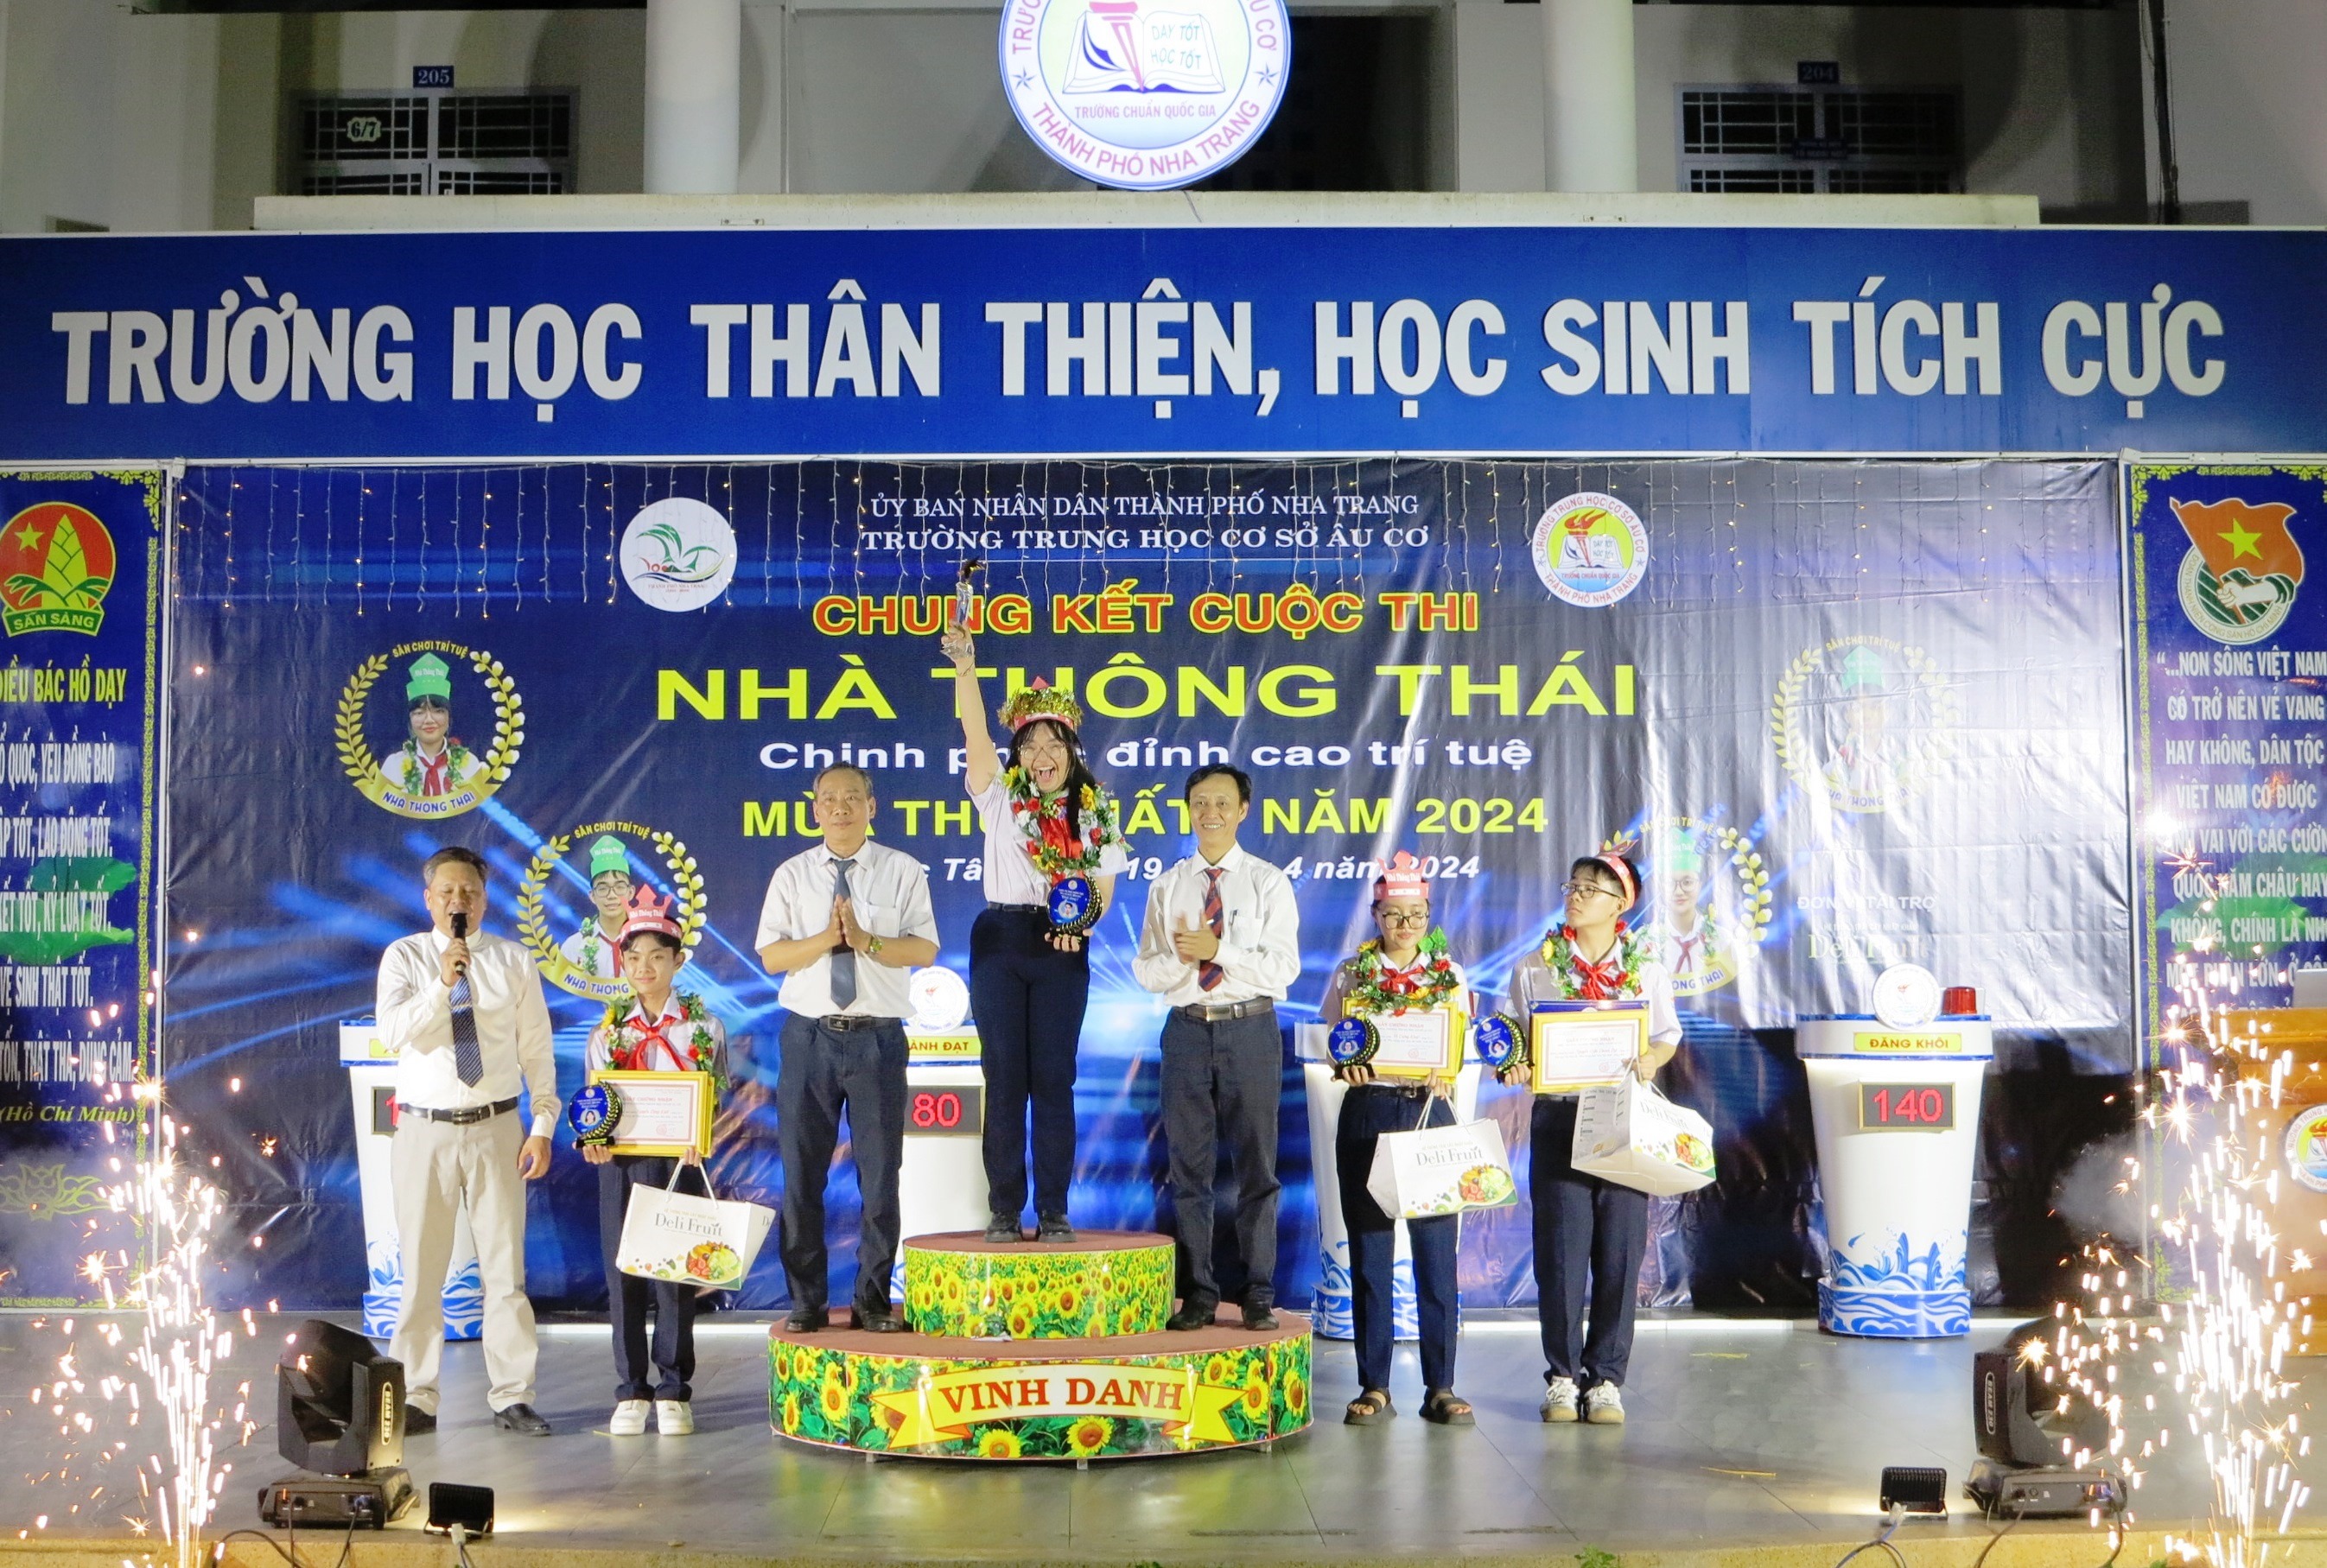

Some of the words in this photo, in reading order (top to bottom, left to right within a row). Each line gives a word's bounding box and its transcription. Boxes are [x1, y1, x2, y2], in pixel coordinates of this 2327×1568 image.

[1255, 20, 1278, 52] CƠ
[417, 69, 450, 84] 205
[1802, 65, 1834, 80] 204
[1075, 102, 1120, 119] TRƯỜNG
[1123, 99, 1161, 118] CHUẨN
[1164, 99, 1196, 119] QUỐC
[1198, 104, 1217, 118] GIA
[350, 120, 378, 140] 6/7
[1033, 102, 1094, 163] THÀNH
[1096, 149, 1145, 176] PHỐ
[1149, 149, 1198, 176] NHA
[1195, 98, 1261, 162] TRANG
[52, 276, 414, 404] TRƯỜNG
[452, 302, 643, 422] HỌC
[690, 278, 940, 398] THÂN
[985, 277, 1281, 420] THIỆN,
[1315, 298, 1507, 419] HỌC
[1541, 298, 1751, 396] SINH
[1792, 276, 2002, 397] TÍCH
[2041, 282, 2226, 420] CỰC
[870, 491, 905, 517] ỦY
[912, 498, 965, 517] BAN
[972, 492, 1046, 517] NHÂN
[1052, 492, 1108, 517] DÂN
[1113, 489, 1205, 516] THÀNH
[1211, 488, 1264, 516] PHỐ
[1271, 496, 1328, 516] NHA
[1332, 495, 1419, 516] TRANG
[1552, 497, 1584, 517] TRUNG
[1586, 495, 1606, 509] HỌC
[861, 524, 1004, 550] TRƯỜNG
[1011, 529, 1129, 550] TRUNG
[1139, 528, 1215, 555] HỌC
[1220, 525, 1268, 549] CƠ
[1274, 520, 1319, 549] SỞ
[1328, 520, 1372, 549] ÂU
[1383, 525, 1429, 549] CƠ
[1544, 572, 1571, 598] THÀNH
[1572, 592, 1591, 604] PHỐ
[1593, 593, 1612, 604] NHA
[1611, 573, 1638, 598] TRANG
[50, 611, 95, 629] SÀNG
[1052, 580, 1172, 636] KẾT
[1188, 581, 1364, 641] CUỘC
[1378, 591, 1478, 632] THI
[391, 643, 411, 658] SÂN
[411, 640, 435, 652] CHƠI
[435, 639, 450, 652] TRÍ
[450, 644, 470, 660] TUỆ
[2213, 644, 2254, 676] SÔNG
[2256, 644, 2291, 682] VIỆT
[2295, 651, 2327, 676] NAM
[33, 659, 65, 703] BÁC
[68, 653, 92, 703] HỒ
[95, 668, 128, 709] DẠY
[658, 653, 897, 721] NHÀ
[1375, 650, 1636, 716] THÁI
[2167, 689, 2188, 721] CÓ
[2191, 686, 2223, 721] TRỞ
[2227, 689, 2258, 721] NÊN
[2261, 686, 2281, 721] VẺ
[2285, 695, 2325, 721] VANG
[8, 727, 39, 792] QUỐC,
[41, 731, 62, 784] YÊU
[63, 725, 92, 784] ĐỒNG
[93, 731, 116, 784] BÀO
[759, 741, 925, 771] Chinh
[1105, 737, 1230, 767] đỉnh
[1251, 746, 1351, 767] cao
[1369, 739, 1425, 766] trí
[1446, 738, 1533, 771] tuệ
[2165, 739, 2196, 765] HAY
[2200, 733, 2256, 771] KHÔNG,
[2260, 733, 2292, 765] DÂN
[2293, 733, 2325, 770] TỘC
[1262, 788, 1392, 835] NĂM
[1415, 797, 1549, 835] 2024
[2176, 778, 2209, 815] VIỆT
[2215, 784, 2247, 809] NAM
[2251, 777, 2272, 809] CÓ
[2276, 779, 2317, 814] ĐƯỢC
[13, 800, 35, 867] TỐT,
[38, 816, 58, 859] LAO
[60, 805, 88, 867] ĐỘNG
[91, 800, 113, 859] TỐT.
[574, 823, 593, 840] SÂN
[594, 821, 616, 833] CHƠI
[617, 821, 633, 834] TRÍ
[633, 825, 652, 841] TUỆ
[2199, 828, 2224, 854] VAI
[2227, 822, 2254, 854] VỚI
[2258, 822, 2287, 854] CÁC
[1127, 857, 1163, 881] 19
[1282, 855, 1303, 879] 4
[1313, 854, 1383, 880] năm
[2172, 866, 2215, 903] QUỐC
[2218, 867, 2253, 898] NĂM
[2255, 866, 2297, 898] CHÂU
[2301, 873, 2327, 898] HAY
[18, 874, 41, 940] TỐT,
[43, 874, 58, 933] KỶ
[60, 879, 87, 941] LUẬT
[89, 874, 111, 933] TỐT.
[1898, 894, 1937, 912] TRỢ
[2170, 911, 2227, 948] KHÔNG,
[2230, 911, 2276, 943] CHÍNH
[2281, 910, 2300, 942] LÀ
[16, 966, 40, 1008] SINH
[41, 955, 69, 1017] THẬT
[71, 949, 94, 1008] TỐT.
[23, 1029, 51, 1091] THẬT
[53, 1029, 77, 1091] THÀ,
[79, 1030, 108, 1082] DŨNG
[943, 1041, 969, 1054] ĐẠT
[1869, 1036, 1912, 1049] ĐĂNG
[1916, 1036, 1949, 1049] KHÔI
[44, 1105, 74, 1122] Chí
[79, 1105, 137, 1124] Minh)
[912, 1092, 962, 1127] 80
[1872, 1088, 1944, 1123] 140
[1416, 1149, 1446, 1166] Deli
[1447, 1146, 1483, 1162] Fruit
[655, 1212, 684, 1230] Deli
[687, 1217, 723, 1236] Fruit
[938, 1378, 1052, 1415] VINH
[1065, 1378, 1186, 1412] DANH
